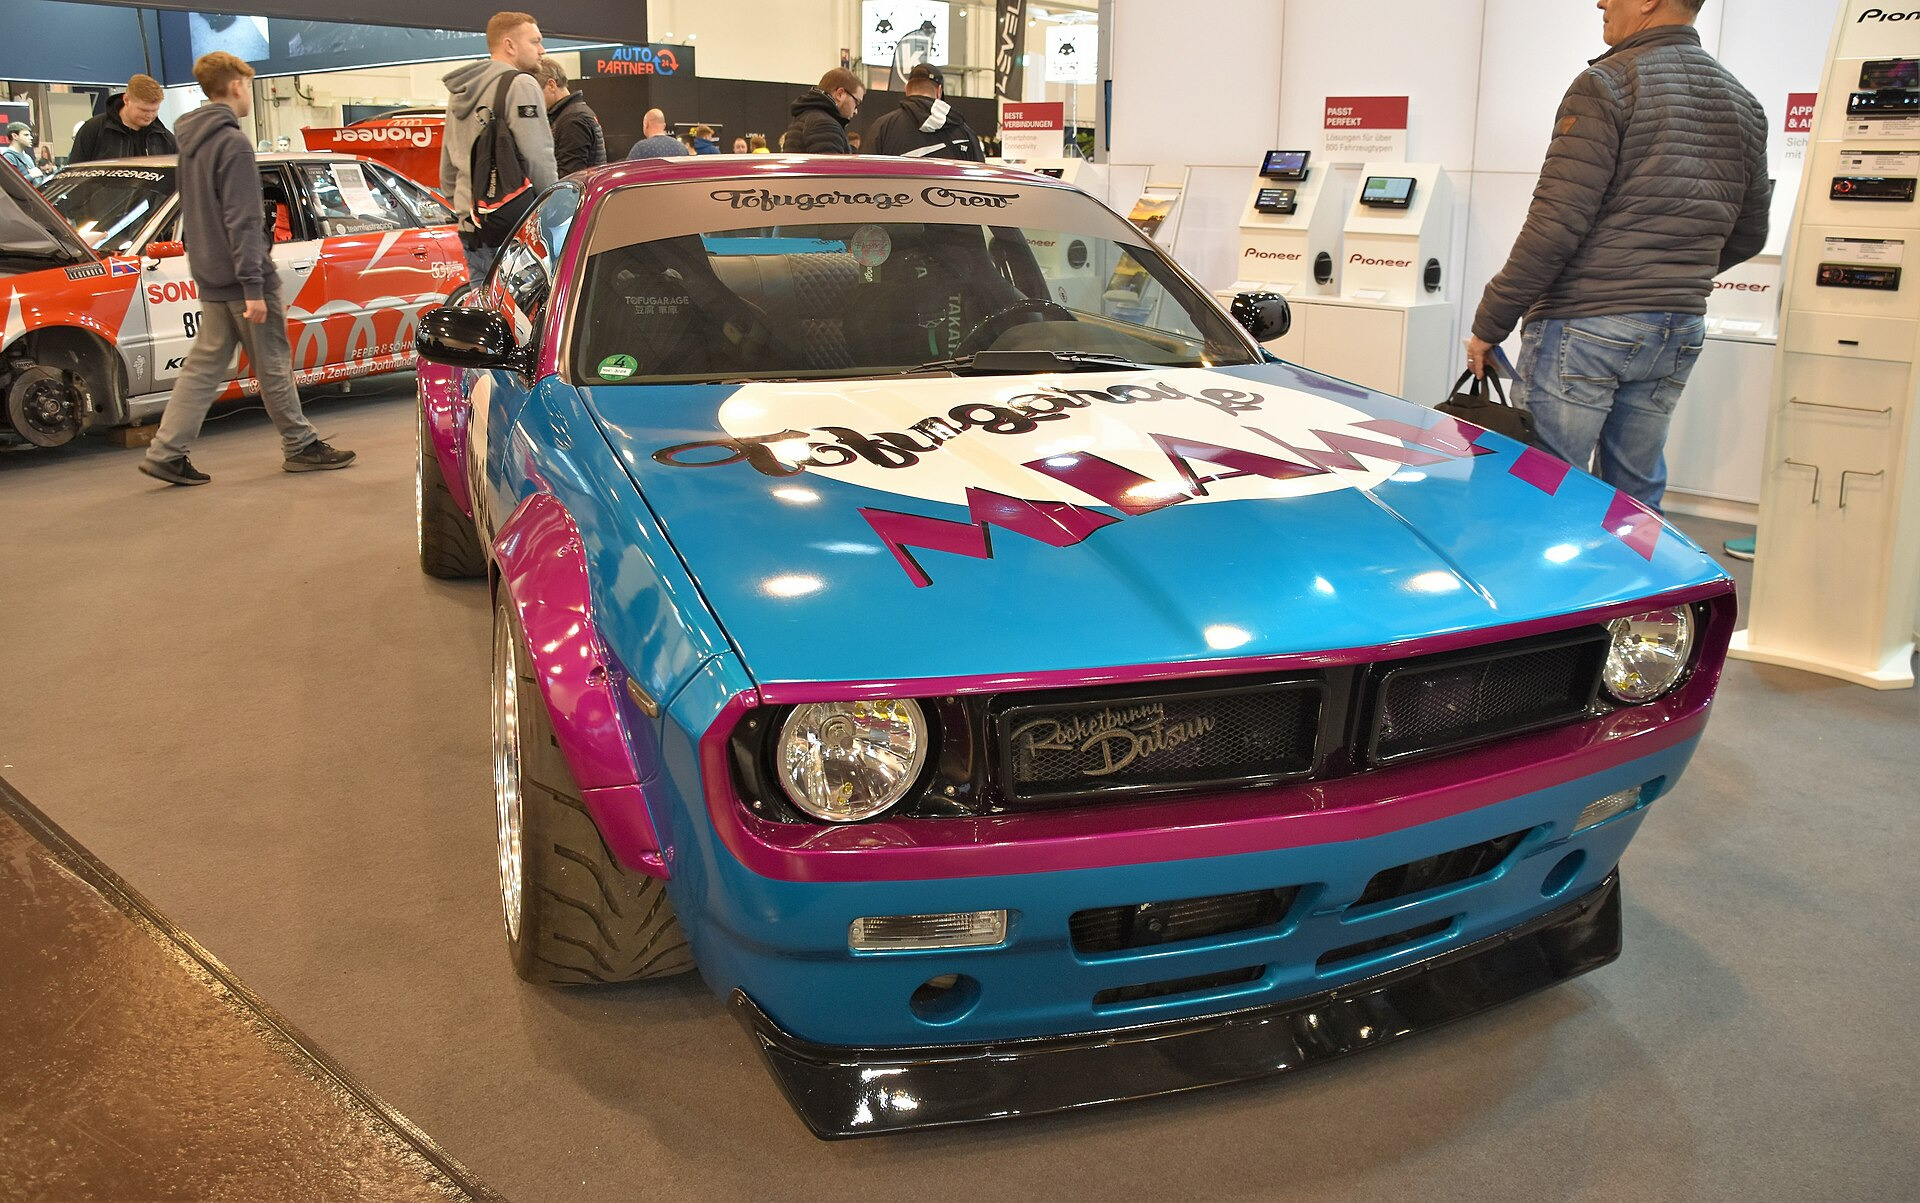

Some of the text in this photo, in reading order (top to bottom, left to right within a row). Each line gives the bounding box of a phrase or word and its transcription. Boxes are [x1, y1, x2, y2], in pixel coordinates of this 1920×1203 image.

[612, 47, 652, 61] AUTO
[597, 60, 654, 75] PARTNER
[662, 59, 670, 67] 24
[1004, 112, 1024, 120] BESTE
[1327, 107, 1353, 116] PASST
[1789, 106, 1813, 116] APP
[1004, 120, 1053, 128] VERBINDUNGEN
[1326, 117, 1362, 126] PERFEKT
[1788, 118, 1797, 128] &
[332, 127, 433, 148] Pioneer
[1325, 133, 1392, 144] Lösungen für über
[1786, 137, 1808, 147] Sich
[1339, 143, 1393, 153] Fahrzeugtypen
[107, 170, 165, 182] LEGENDEN
[710, 186, 1020, 211] Tofugarage Crew
[1026, 238, 1056, 247] oneer
[1244, 247, 1302, 261] Pioneer
[1349, 253, 1412, 268] Pioneer
[147, 280, 200, 304] SON
[1712, 281, 1770, 292] oneer
[625, 296, 689, 305] TOFUGARAGE
[948, 293, 961, 357] TAKAT
[351, 345, 380, 359] PEPER
[388, 339, 416, 353] SÖHN
[613, 355, 627, 367] 4
[294, 371, 326, 385] wagen
[327, 364, 368, 379] Zentrum
[369, 357, 412, 372] Dortmund
[1010, 702, 1164, 758] Rocketbunny
[1080, 714, 1216, 776] Datsun
